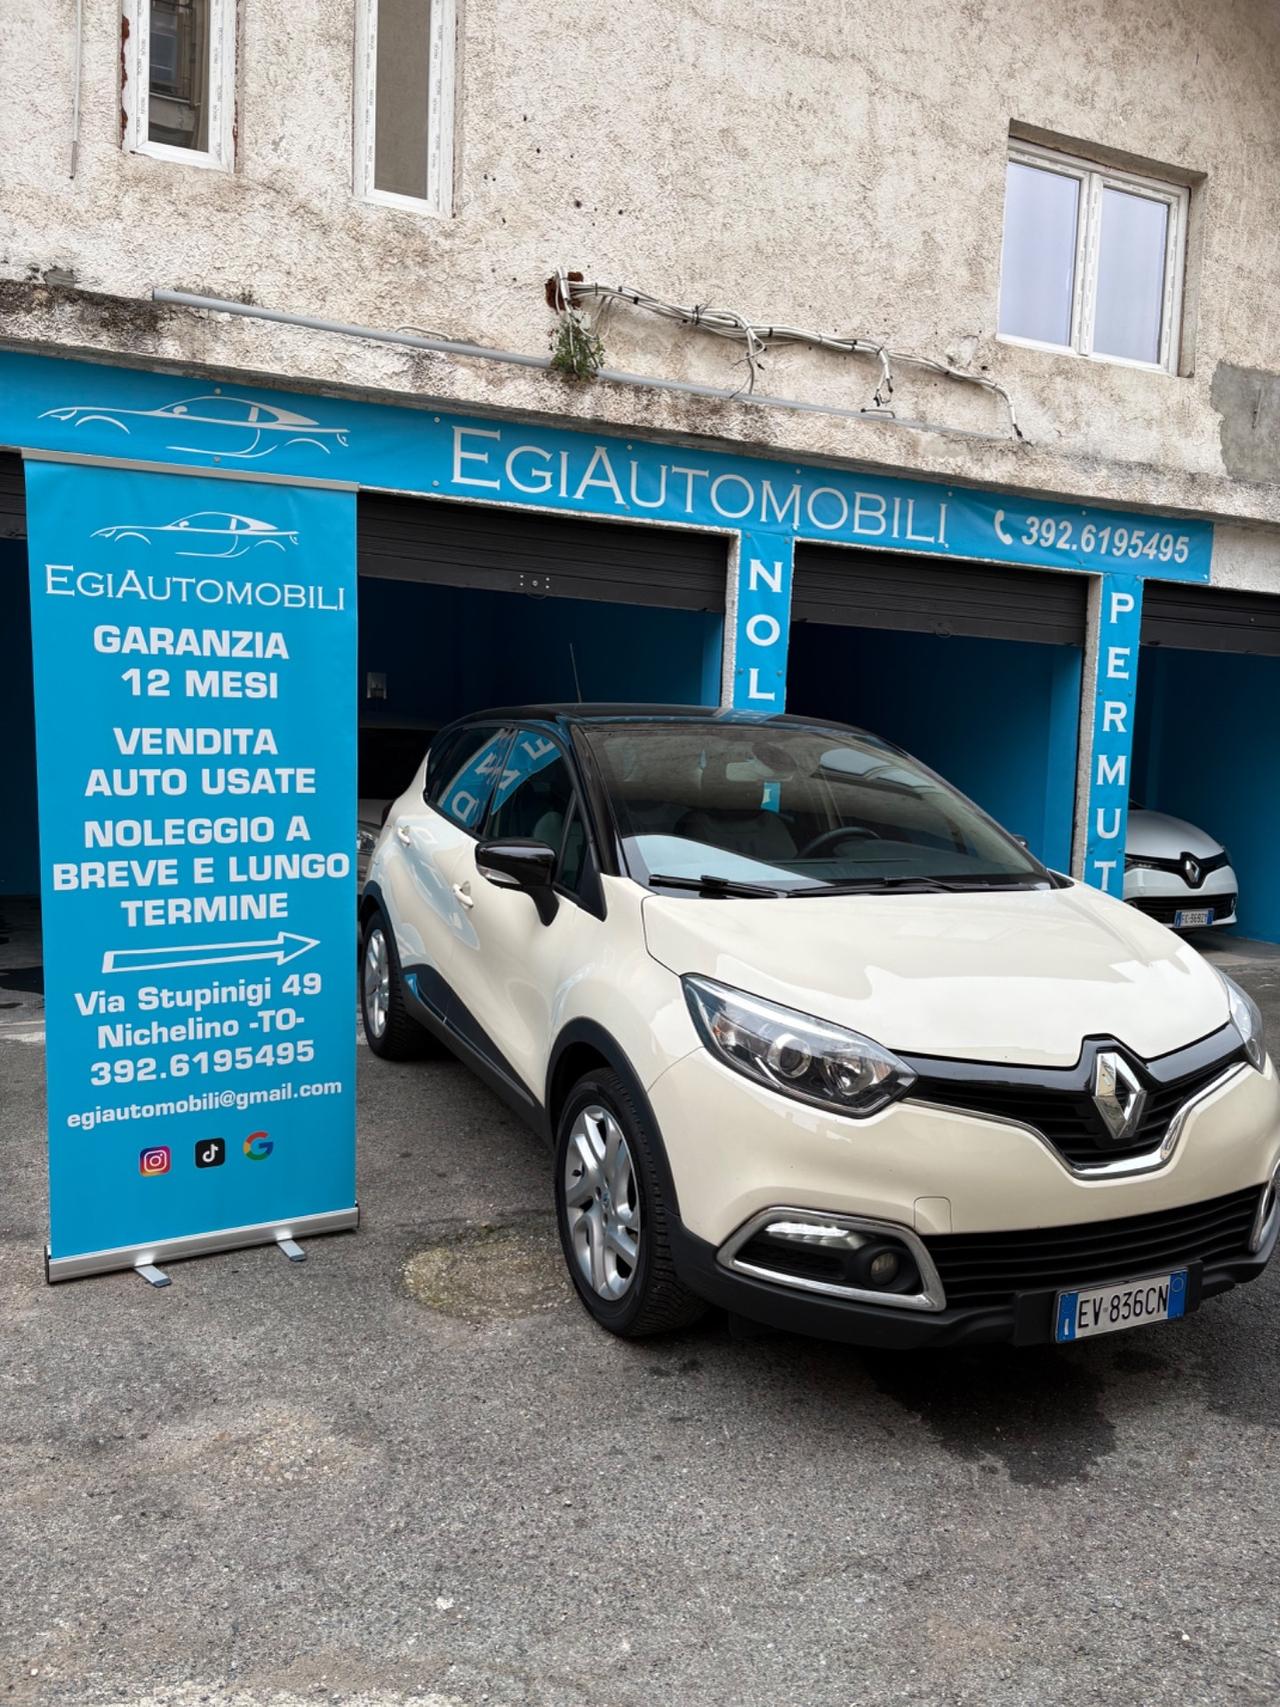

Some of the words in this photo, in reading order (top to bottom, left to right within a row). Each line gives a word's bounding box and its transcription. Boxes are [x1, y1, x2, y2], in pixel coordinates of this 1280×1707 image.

[1021, 516, 1190, 565] 392.6195495
[93, 625, 289, 660] GARANZIA
[121, 668, 170, 697] 12
[185, 670, 278, 698] MESI
[113, 728, 278, 755] VENDITA
[84, 768, 187, 797] AUTO
[201, 767, 316, 795] USATE
[84, 817, 275, 849] NOLEGGIO
[285, 816, 311, 842] A
[53, 859, 178, 891] BREVE
[193, 858, 214, 884] E
[228, 852, 350, 882] LUNGO
[120, 892, 289, 927] TERMINE
[74, 990, 125, 1016] Via
[138, 978, 272, 1013] Stupinigi
[282, 972, 322, 996] 49
[97, 1017, 240, 1050] Nichelino
[249, 1008, 305, 1033] -TO-
[91, 1039, 315, 1087] 392.6195495
[67, 1079, 342, 1130] egiautomobili@gmail.com
